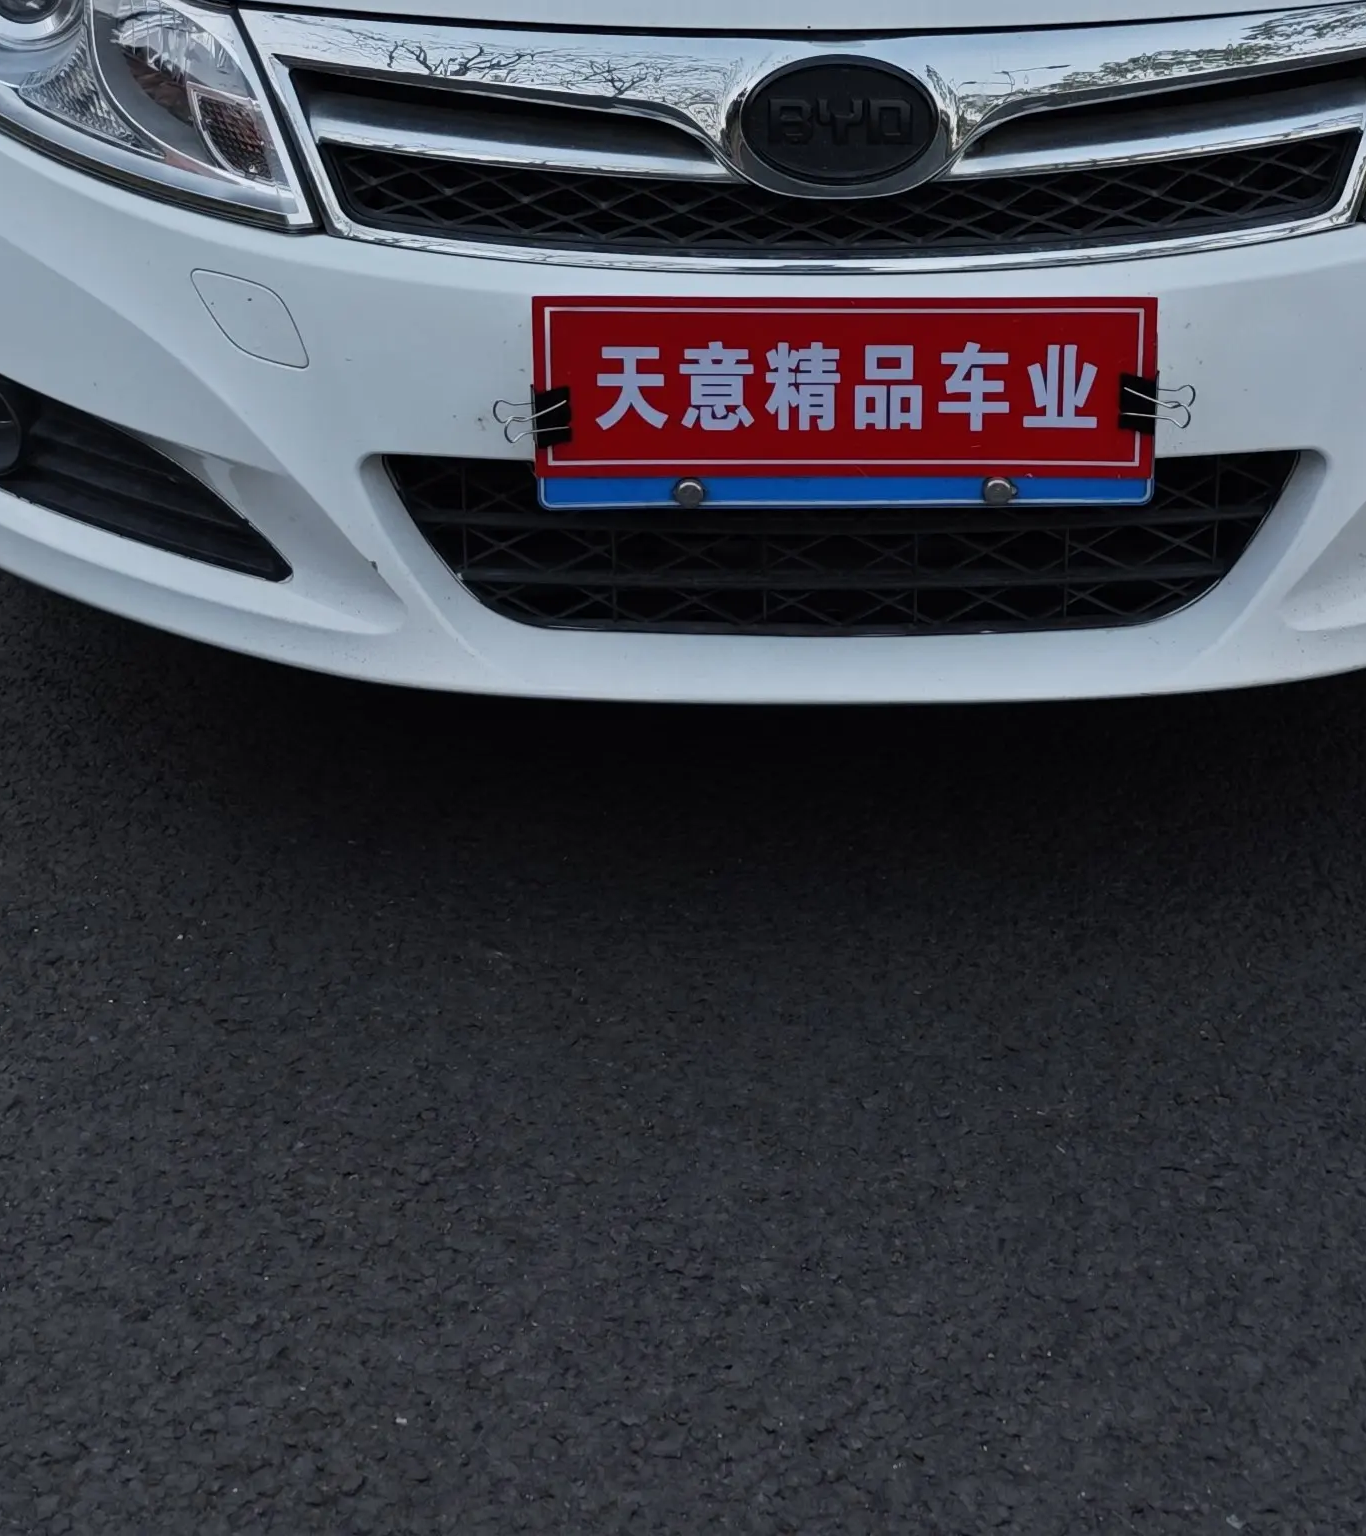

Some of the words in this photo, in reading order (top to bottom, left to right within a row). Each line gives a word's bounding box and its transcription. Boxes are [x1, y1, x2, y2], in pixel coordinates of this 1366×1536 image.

[767, 98, 913, 145] BYD
[595, 341, 1098, 431] 天意精品车业
